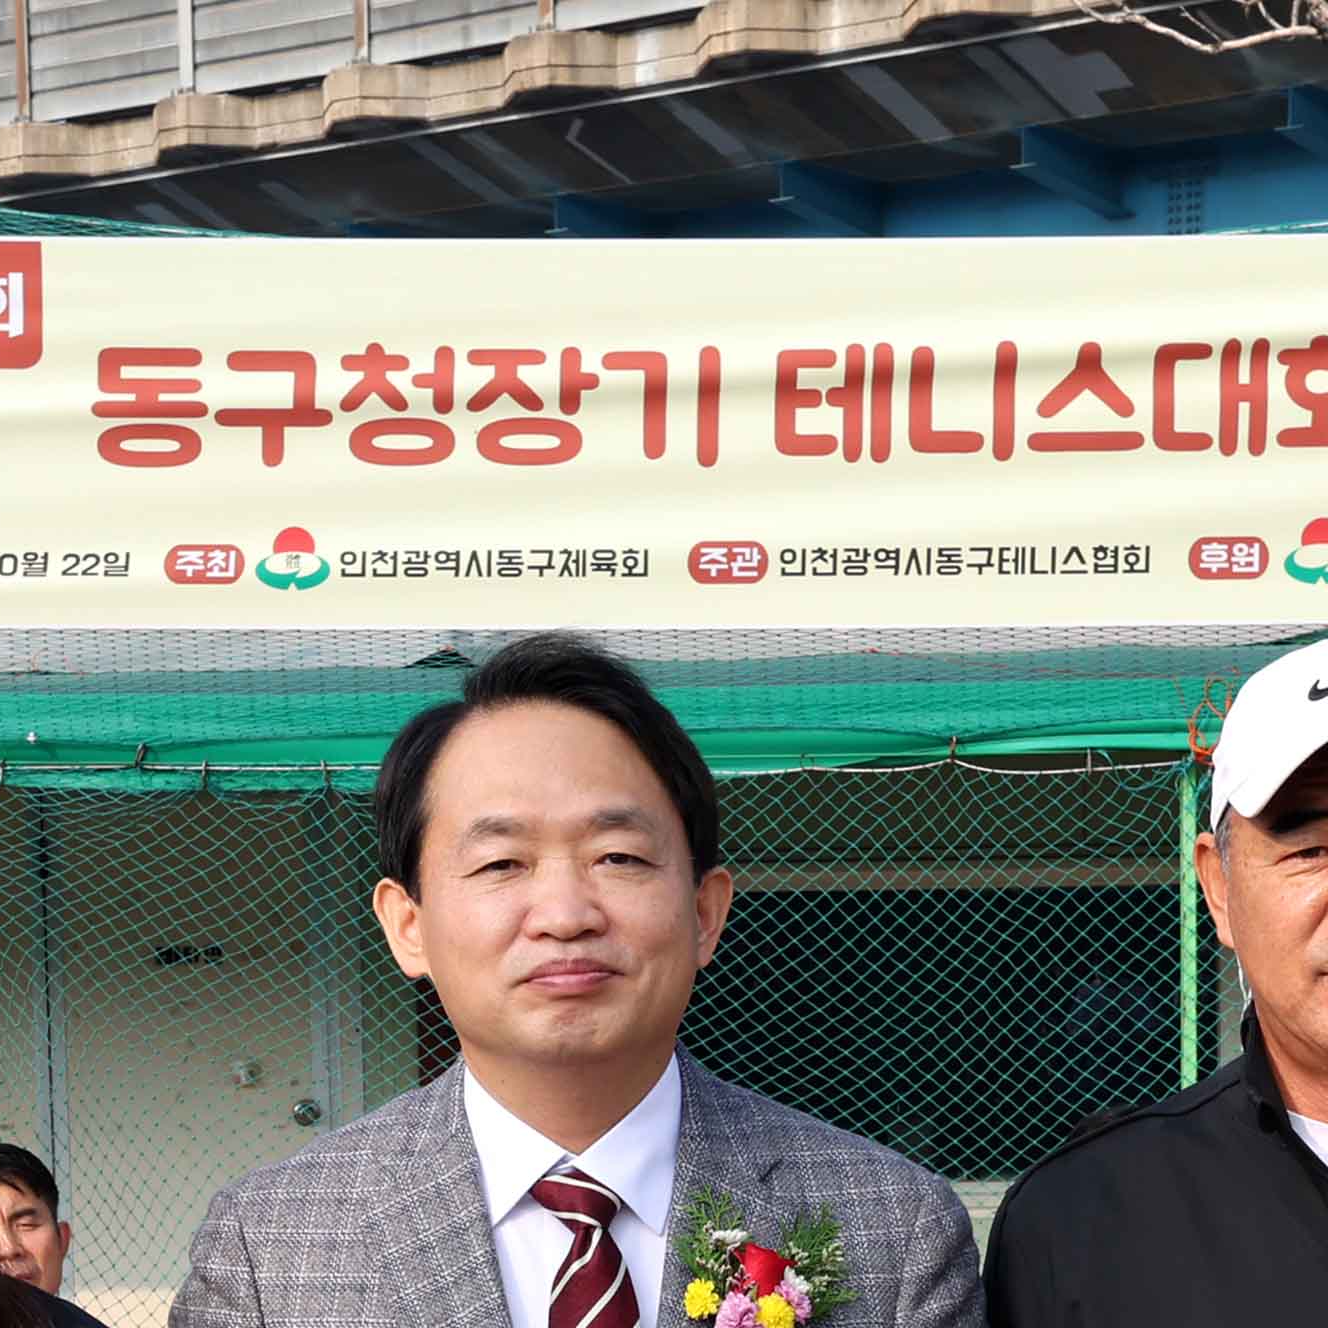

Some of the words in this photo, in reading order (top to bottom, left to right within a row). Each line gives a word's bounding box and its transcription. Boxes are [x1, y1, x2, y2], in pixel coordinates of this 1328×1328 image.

[93, 342, 721, 468] 동구청장기
[61, 551, 130, 577] 22일
[175, 549, 236, 578] 주최
[340, 548, 649, 578] 인천광역시동구체육회
[699, 547, 761, 577] 주관
[779, 544, 1151, 577] 인천광역시동구테니스협회
[1199, 542, 1260, 573] 후원
